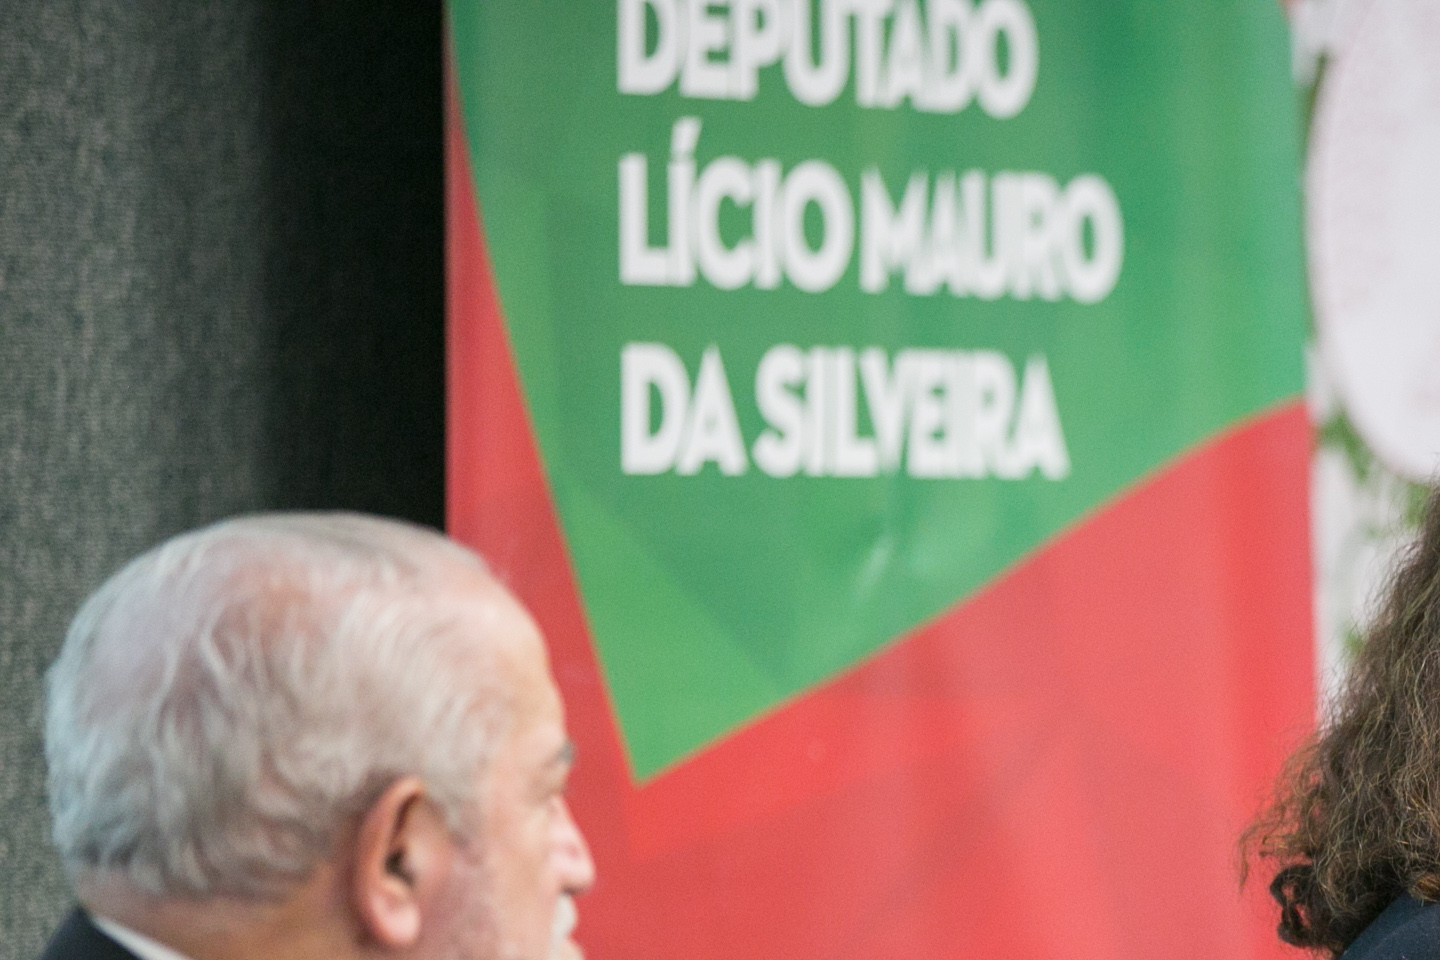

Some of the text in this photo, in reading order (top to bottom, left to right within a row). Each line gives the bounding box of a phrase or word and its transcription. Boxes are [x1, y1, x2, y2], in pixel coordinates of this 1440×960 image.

[616, 0, 1040, 118] DEPUTADO
[616, 116, 1125, 305] LÍCIO MAURO
[619, 341, 1072, 481] DA SILVEIRA
